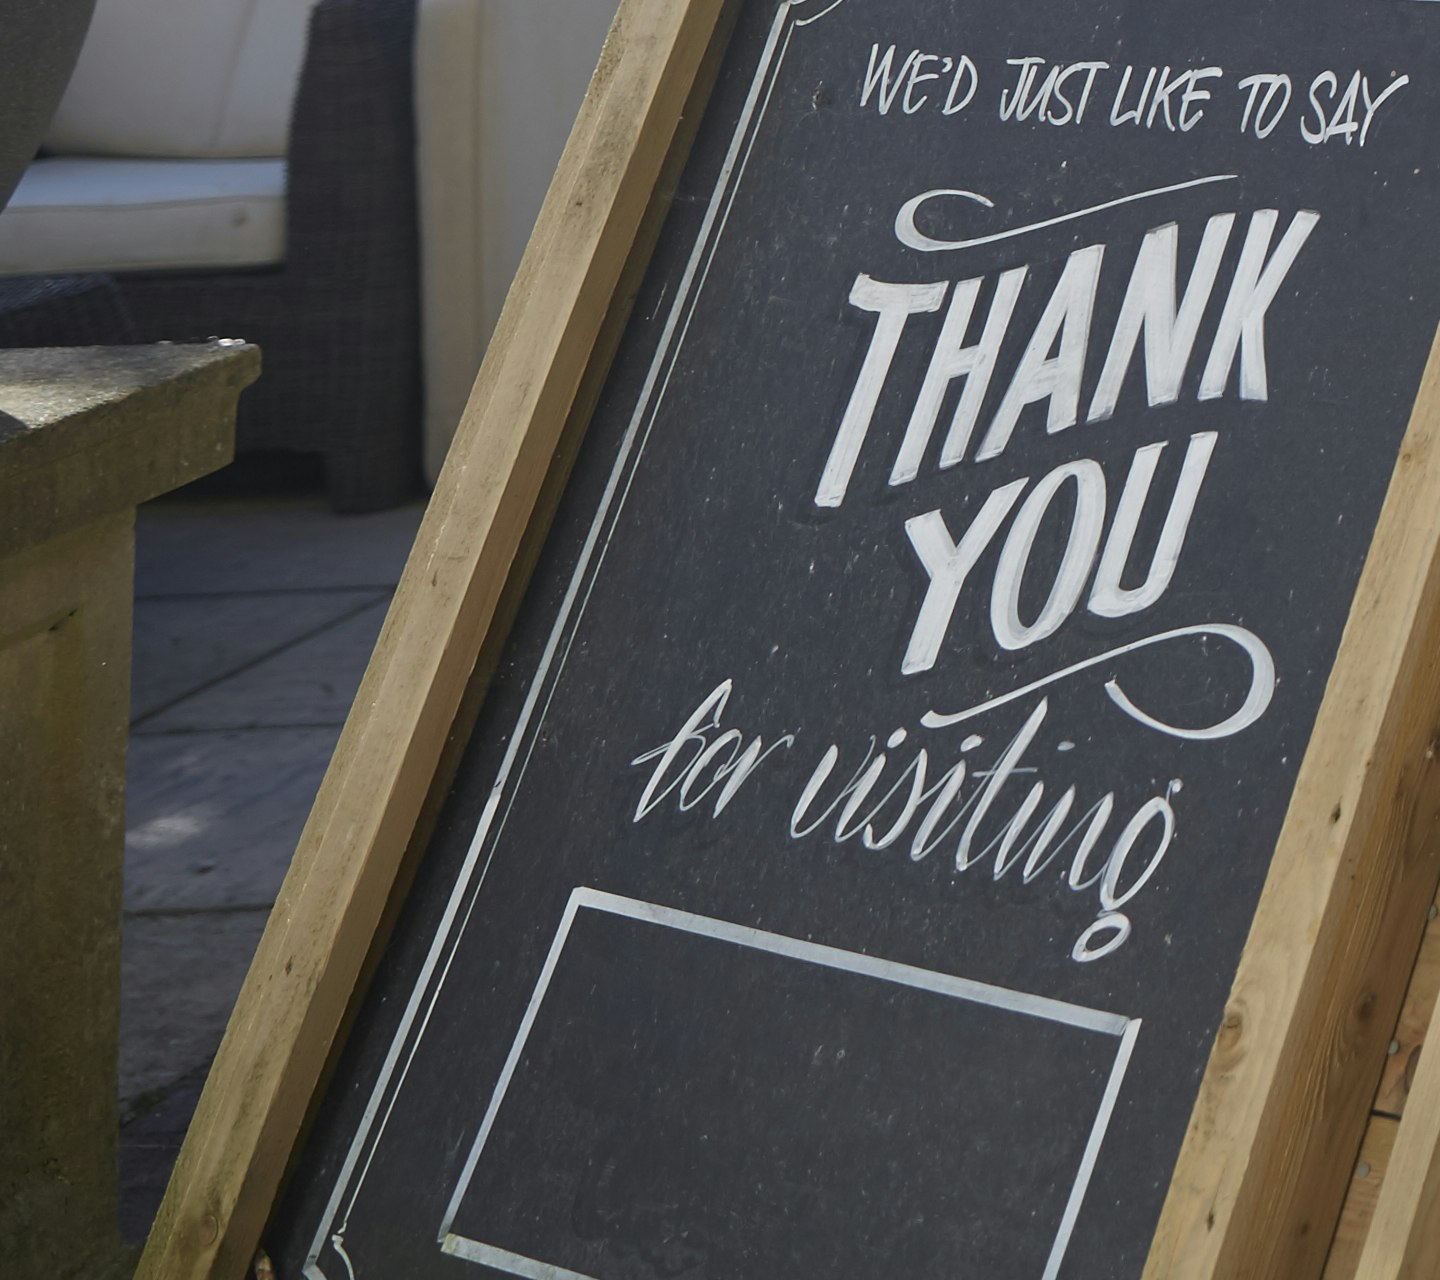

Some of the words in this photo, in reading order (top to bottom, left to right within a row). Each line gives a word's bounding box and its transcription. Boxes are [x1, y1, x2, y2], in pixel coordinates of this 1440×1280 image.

[859, 43, 978, 117] WE'D
[999, 56, 1109, 127] JUST
[1109, 66, 1222, 133] LIKE
[1237, 72, 1291, 140] TO
[1299, 69, 1411, 148] SAY
[813, 208, 1321, 508] THANK
[900, 431, 1219, 676] YOU
[630, 678, 794, 825] for
[788, 697, 1183, 963] visiting
